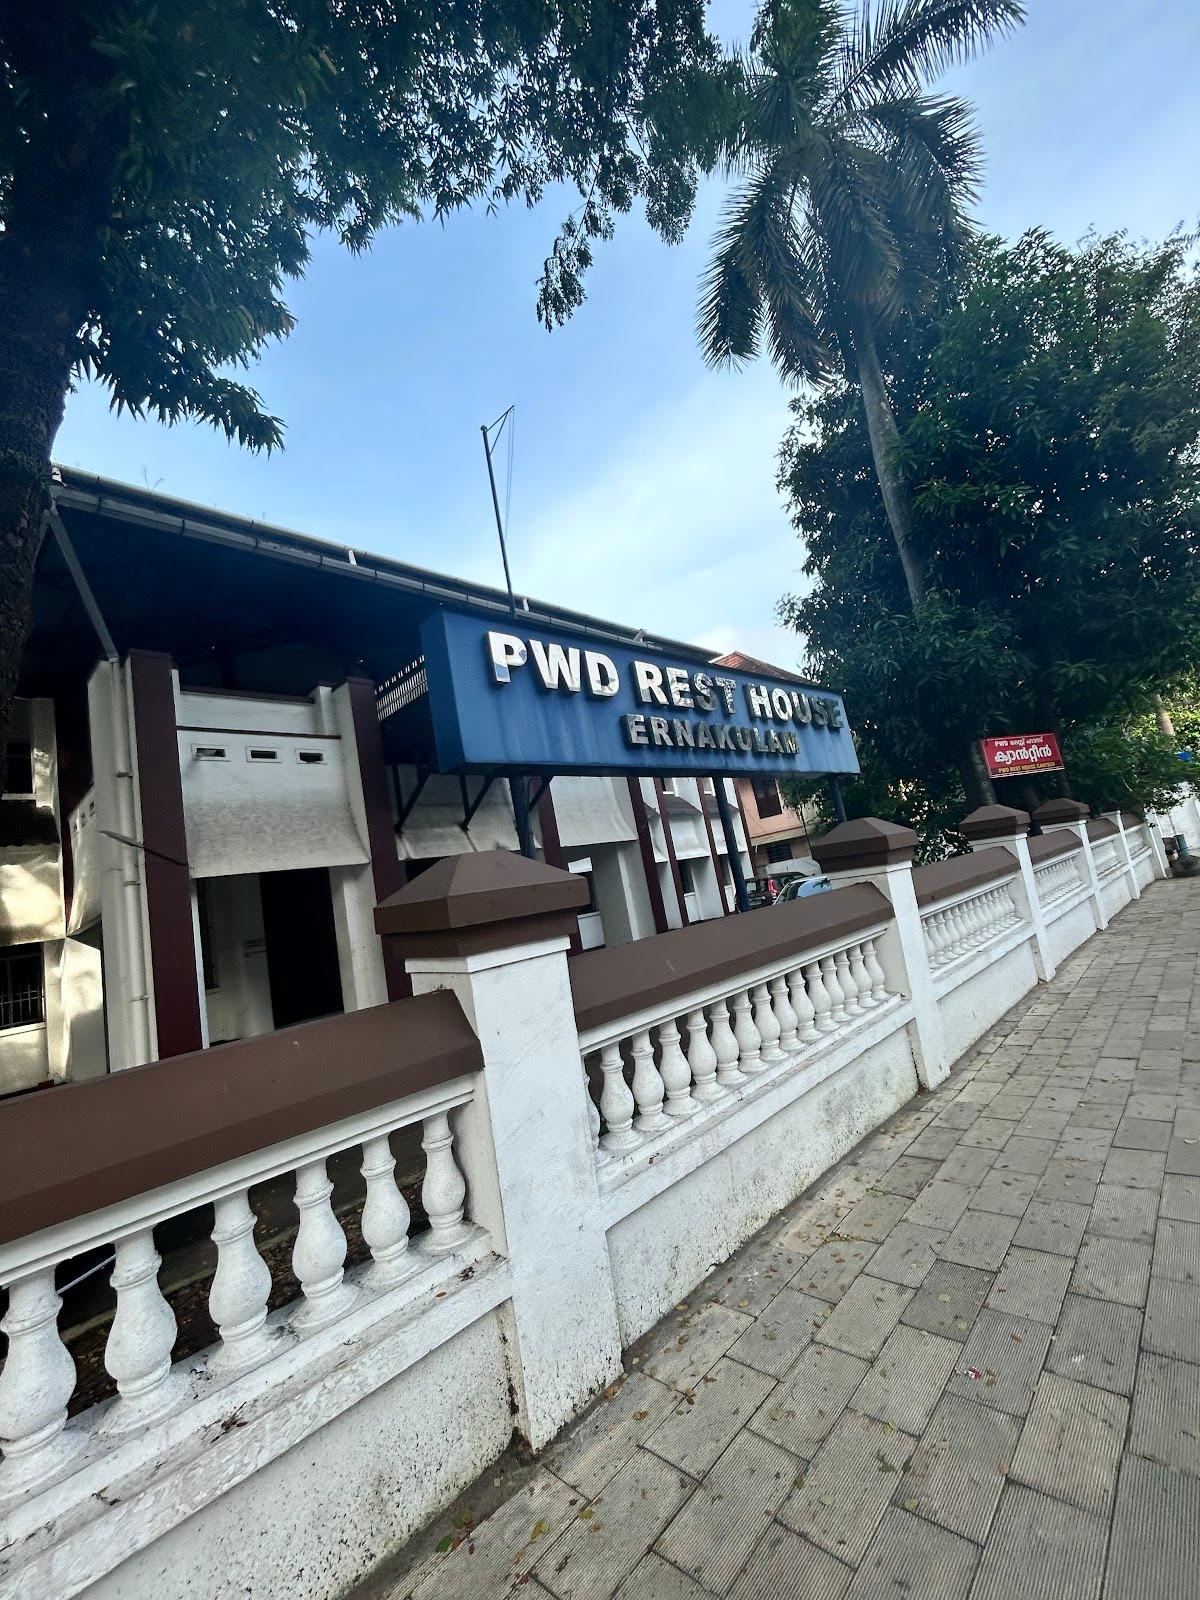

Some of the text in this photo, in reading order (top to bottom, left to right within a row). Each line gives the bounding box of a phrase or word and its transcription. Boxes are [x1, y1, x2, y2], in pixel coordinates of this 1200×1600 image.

[486, 630, 844, 730] PWD REST HOUSE
[622, 713, 800, 756] ERNAKULAM
